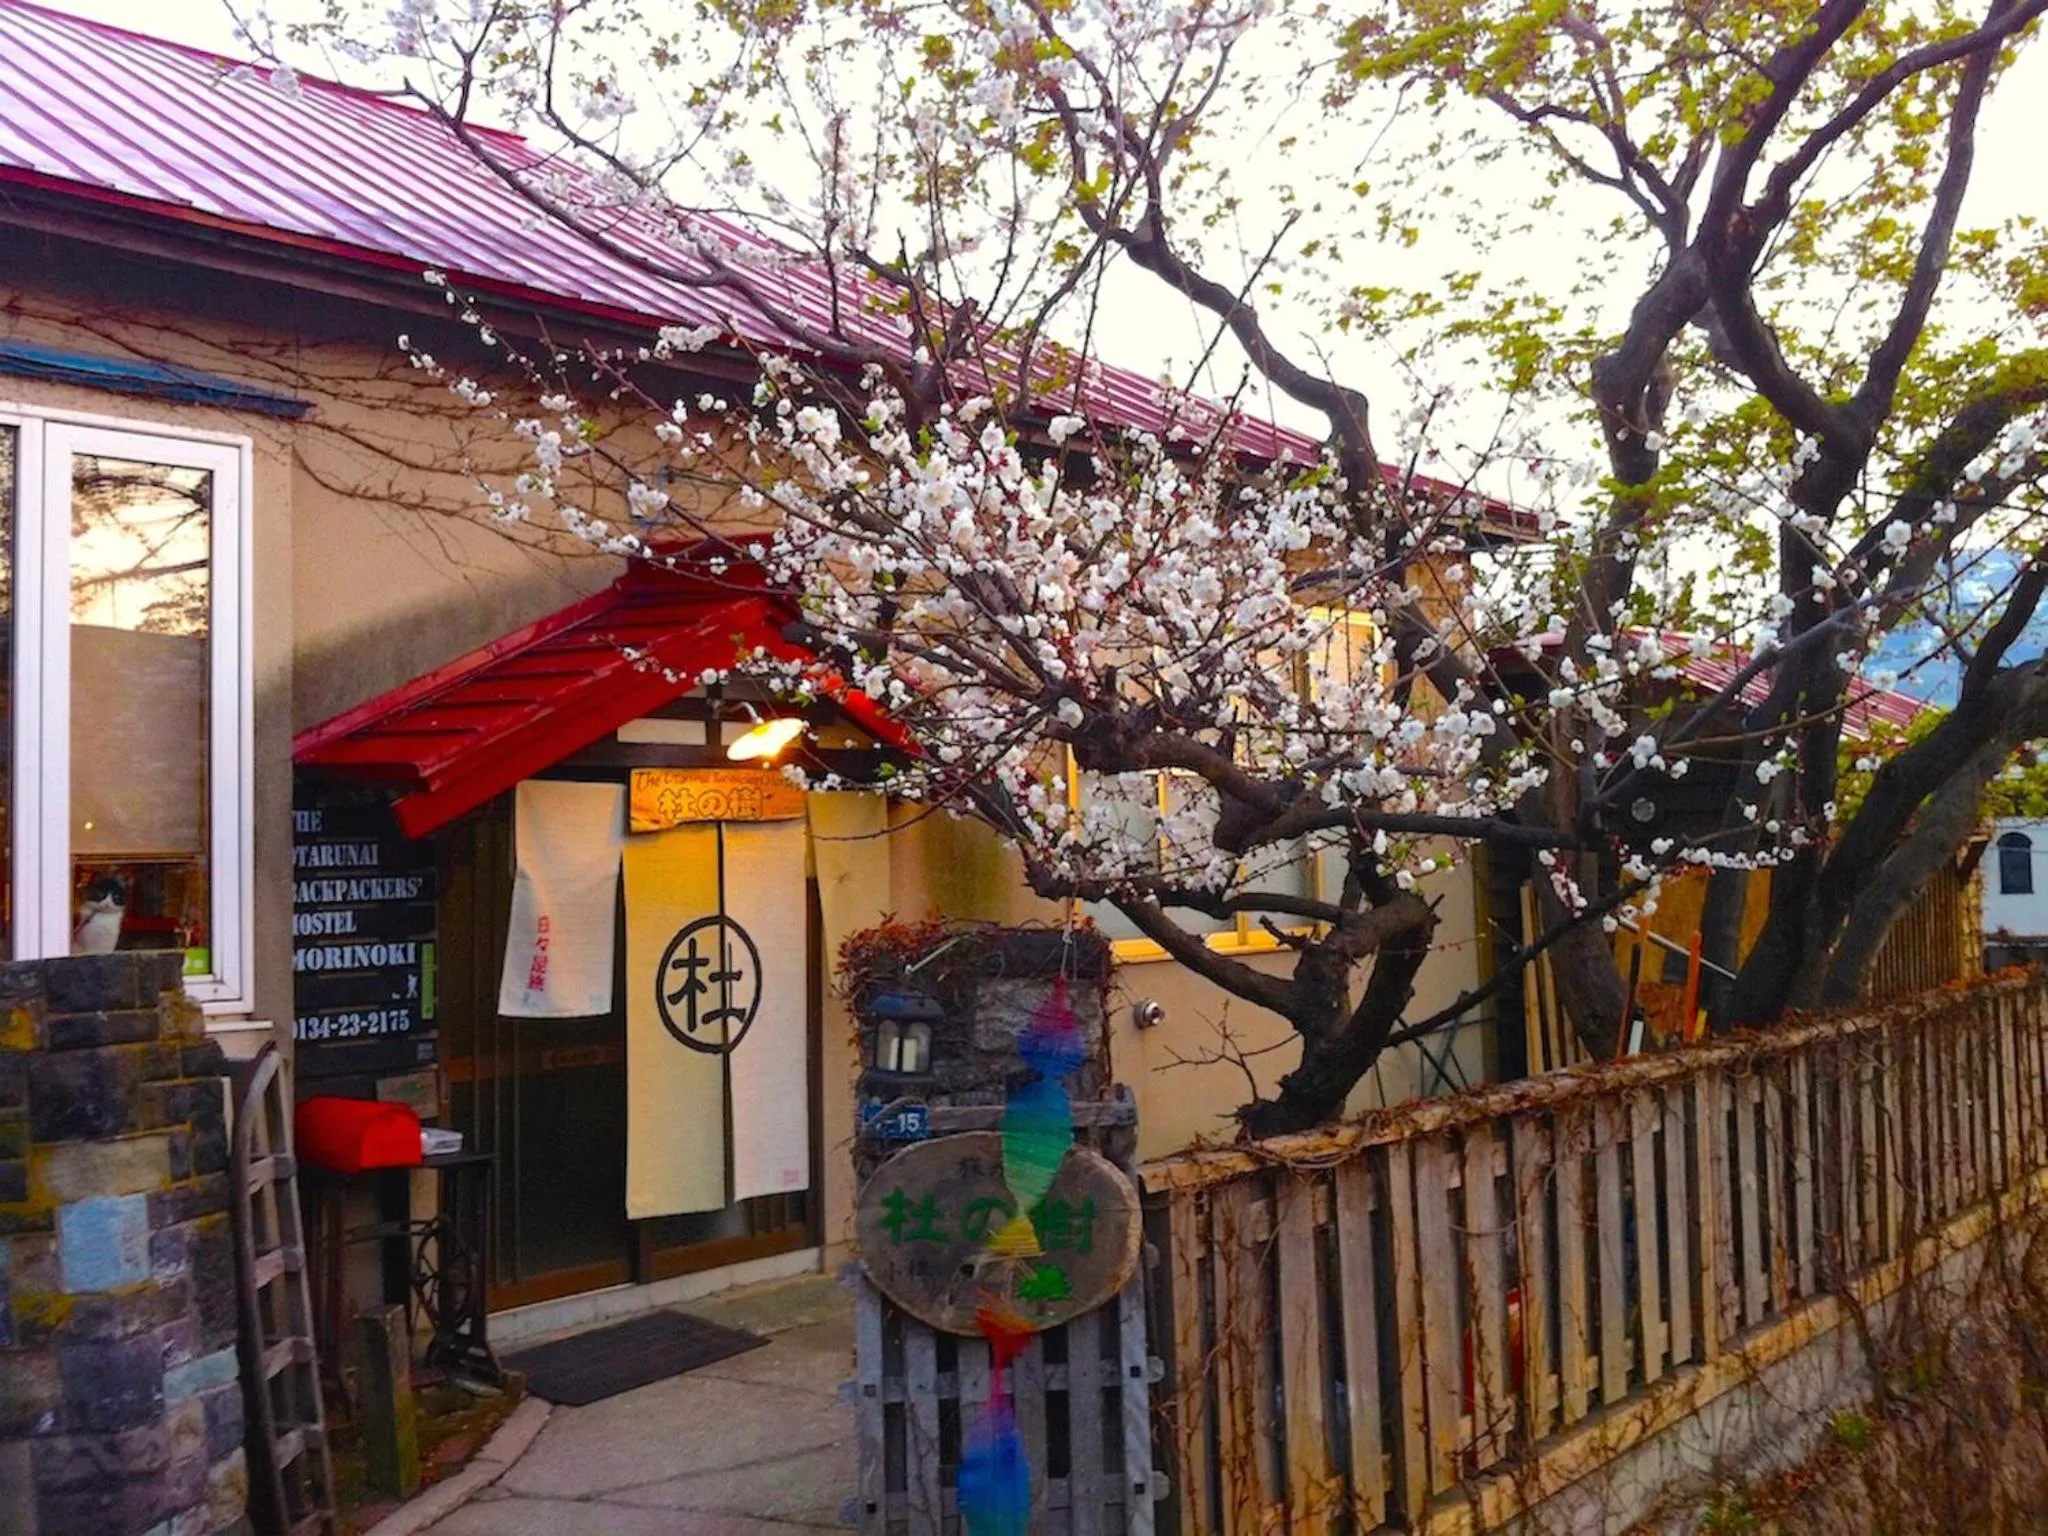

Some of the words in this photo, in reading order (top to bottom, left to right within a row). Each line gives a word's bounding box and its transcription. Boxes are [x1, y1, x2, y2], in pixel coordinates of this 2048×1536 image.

[656, 786, 765, 819] 杜の樹
[292, 811, 322, 832] HE
[667, 936, 747, 1033] 杜
